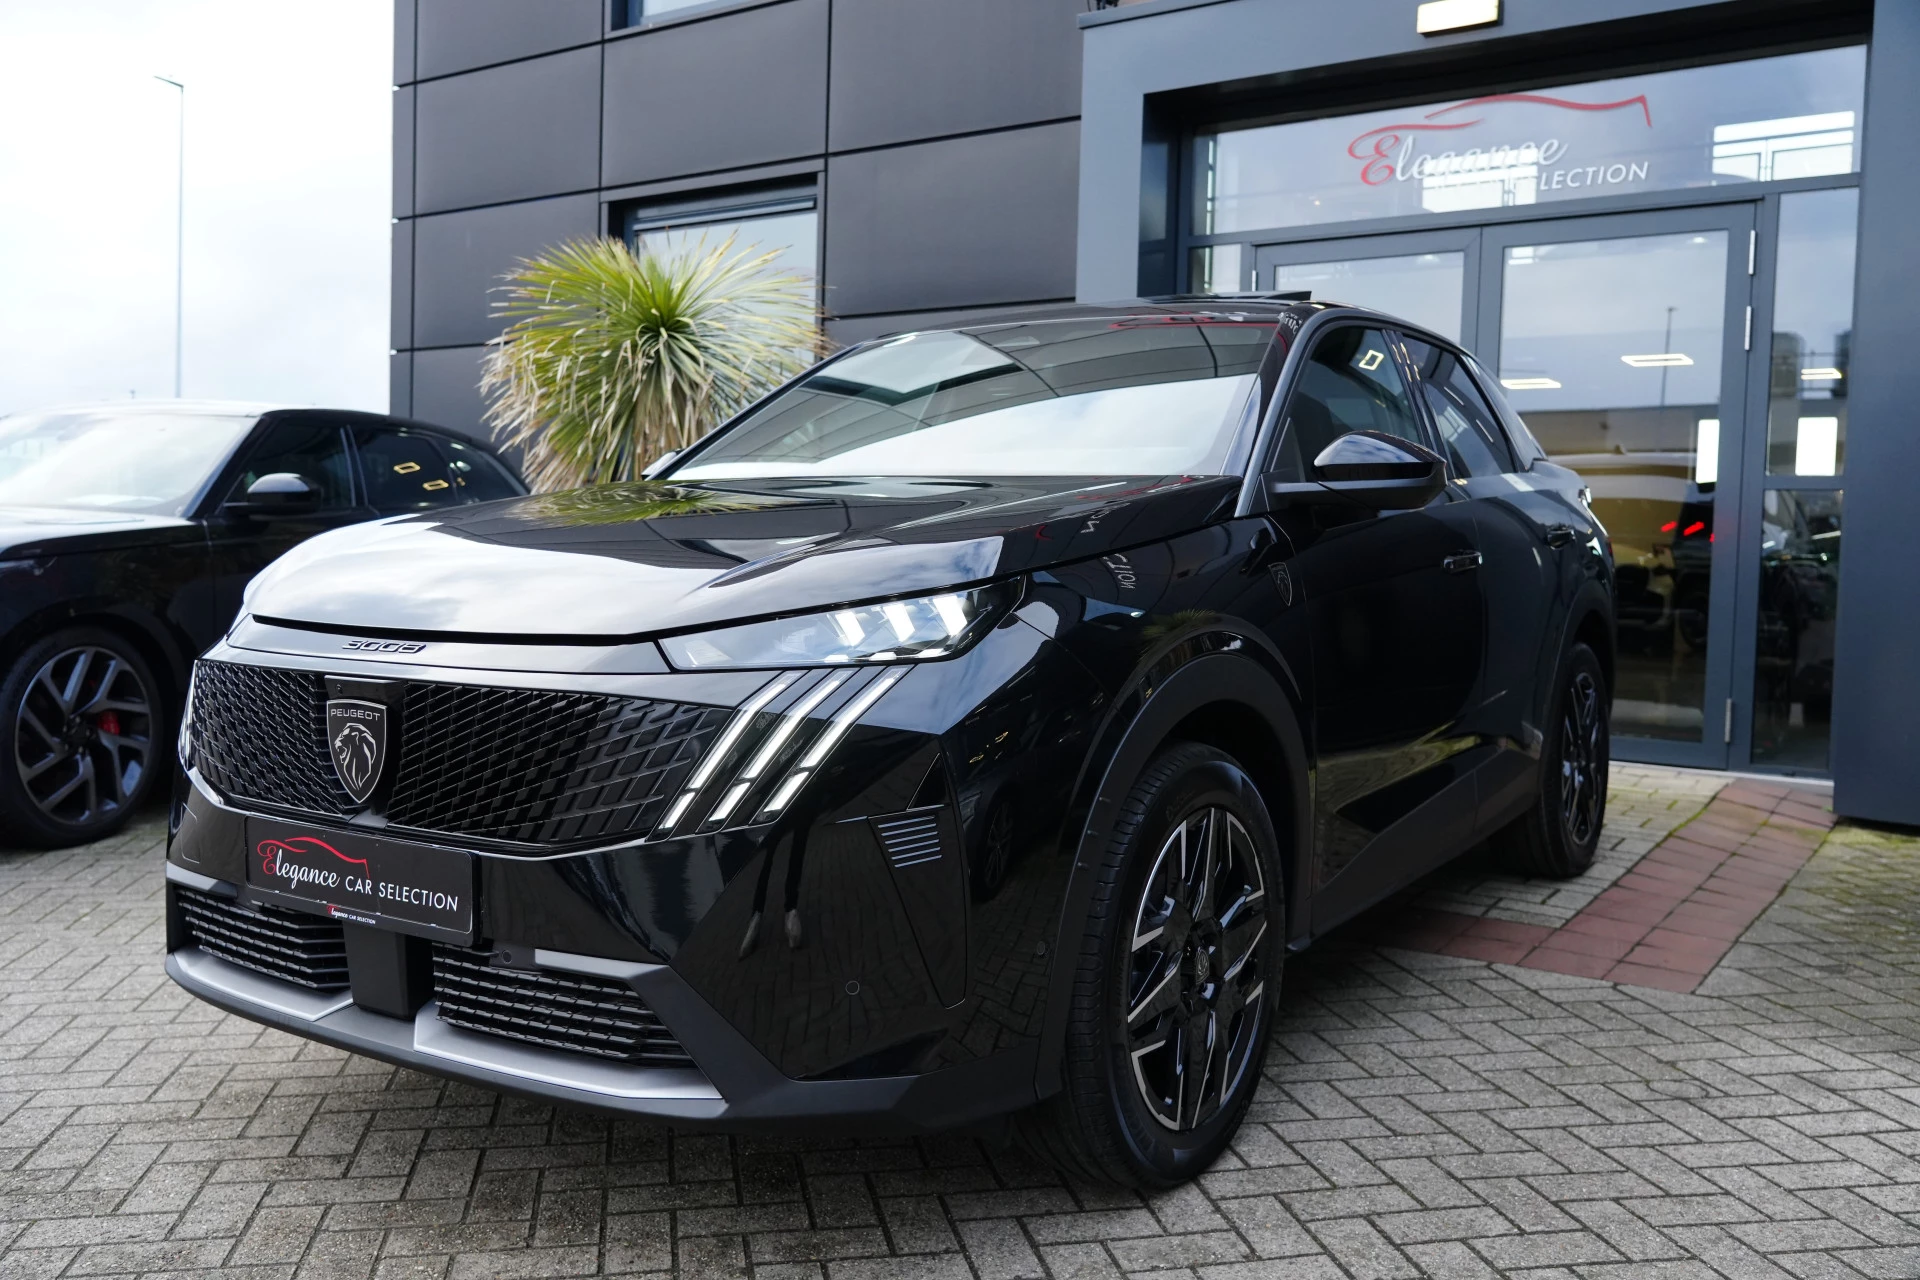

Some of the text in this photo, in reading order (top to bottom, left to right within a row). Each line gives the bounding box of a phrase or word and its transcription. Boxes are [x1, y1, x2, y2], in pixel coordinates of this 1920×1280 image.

[1506, 161, 1649, 193] LECTION
[342, 640, 427, 654] 3008
[330, 708, 381, 721] PEUGEOT
[257, 840, 459, 912] Elegance CAR SELECTION
